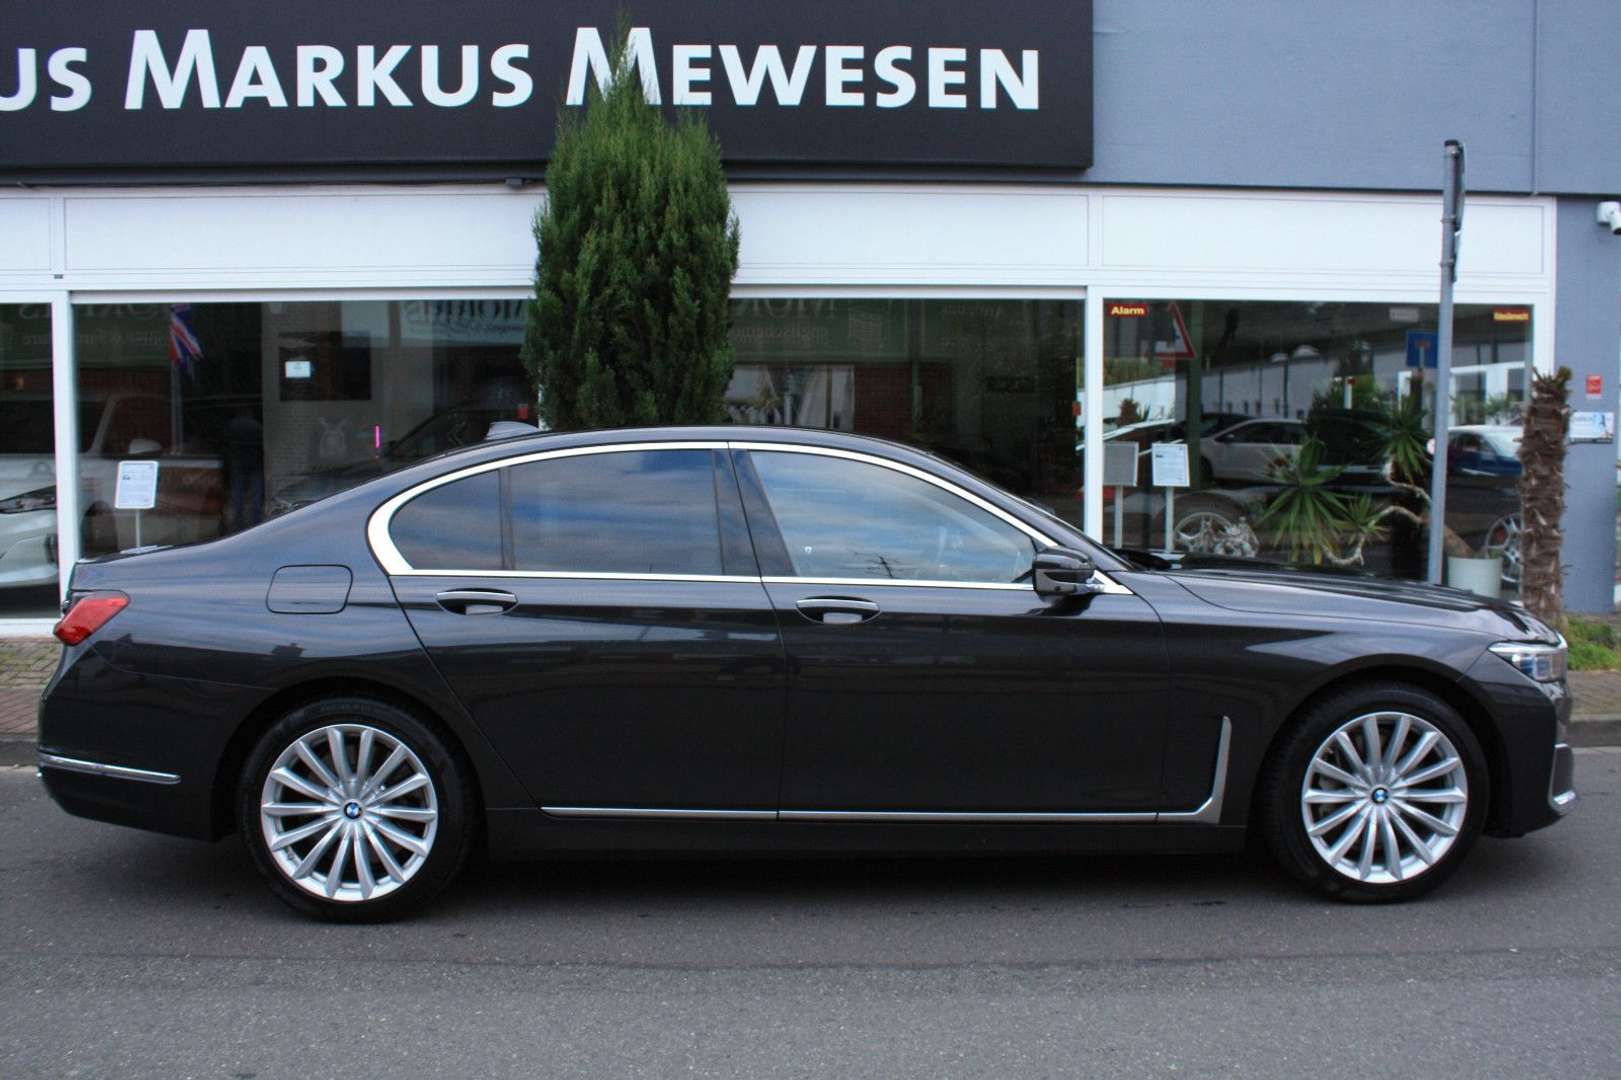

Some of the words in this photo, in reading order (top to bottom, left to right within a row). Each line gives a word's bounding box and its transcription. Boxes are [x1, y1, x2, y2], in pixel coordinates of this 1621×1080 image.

[124, 28, 533, 110] MARKUS
[566, 26, 1039, 110] MEWESEN
[1111, 306, 1145, 316] Alarm
